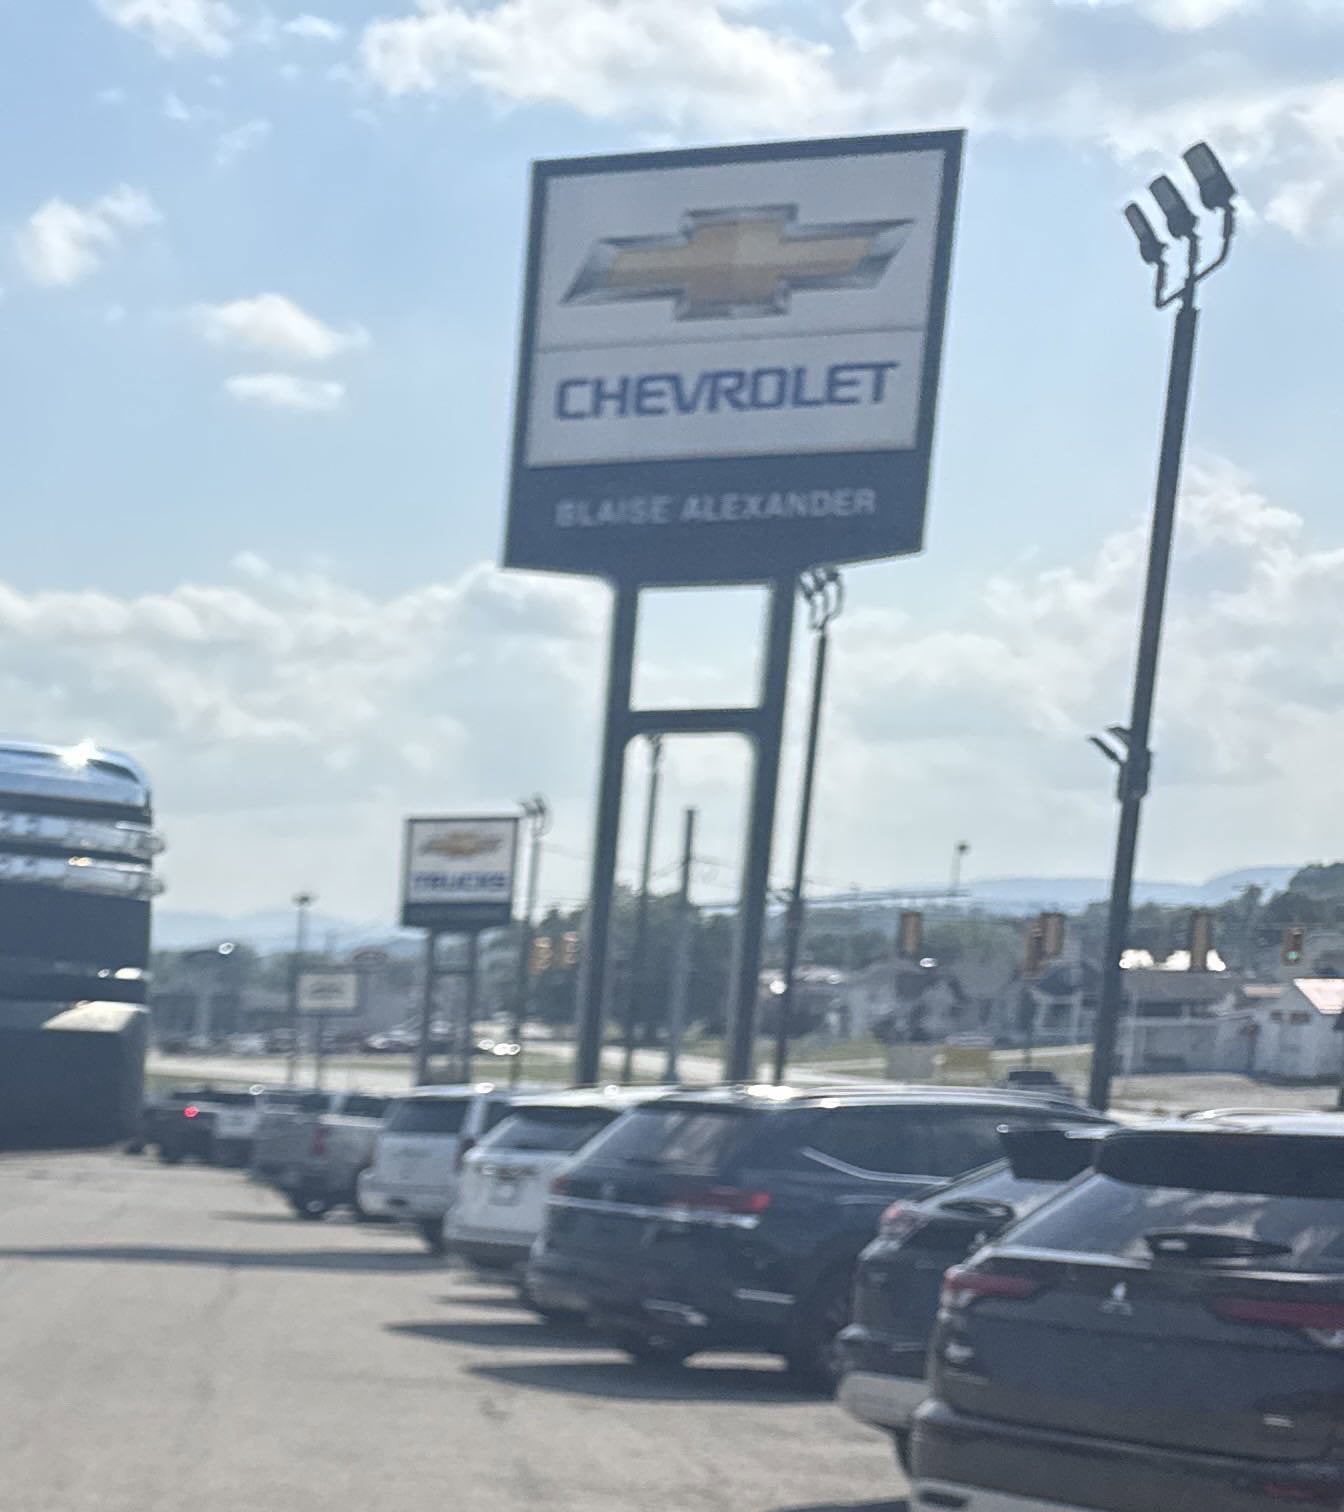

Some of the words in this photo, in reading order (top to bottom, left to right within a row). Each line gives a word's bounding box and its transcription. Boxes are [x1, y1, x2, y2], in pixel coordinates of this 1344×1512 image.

[555, 361, 899, 420] CHEVROLET
[555, 497, 669, 527] BLAISE
[679, 488, 876, 522] ALEXANDER
